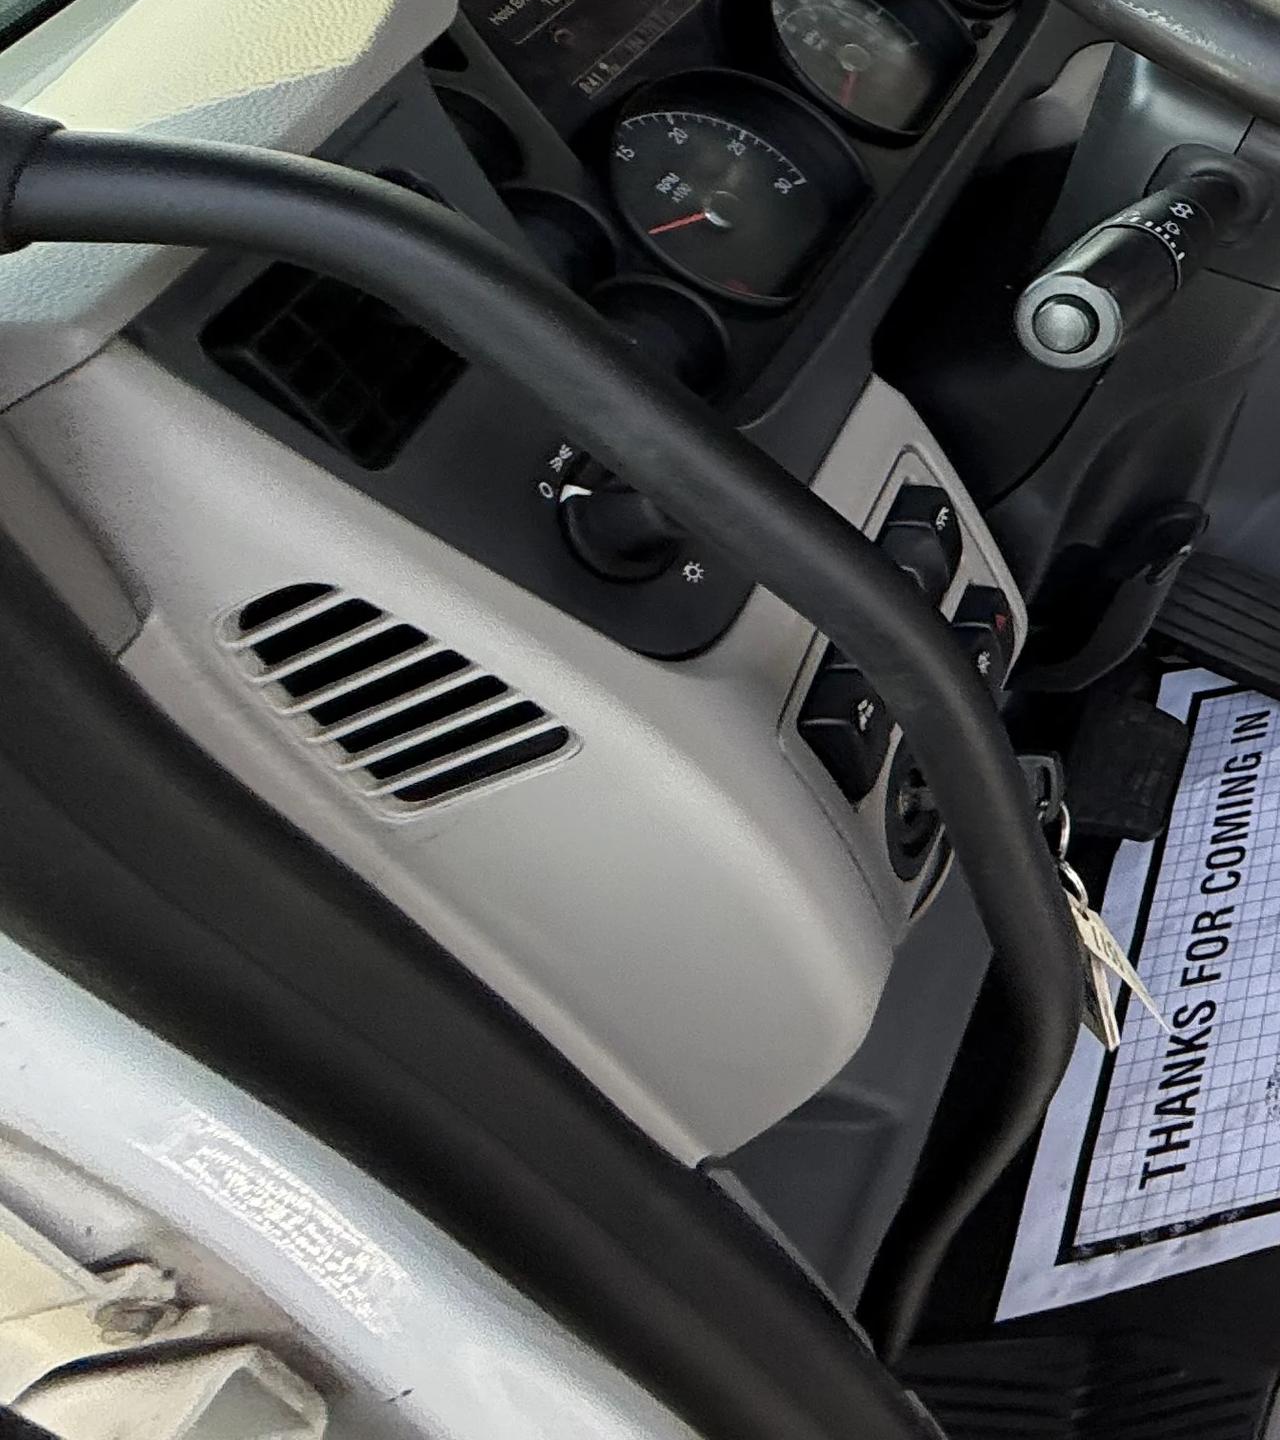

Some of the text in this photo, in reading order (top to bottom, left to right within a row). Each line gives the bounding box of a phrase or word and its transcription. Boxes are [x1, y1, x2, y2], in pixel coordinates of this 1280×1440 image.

[668, 127, 689, 145] 20
[616, 145, 635, 161] 15
[774, 177, 793, 195] 30
[1138, 709, 1271, 1188] THANKS FOR COMING IN
